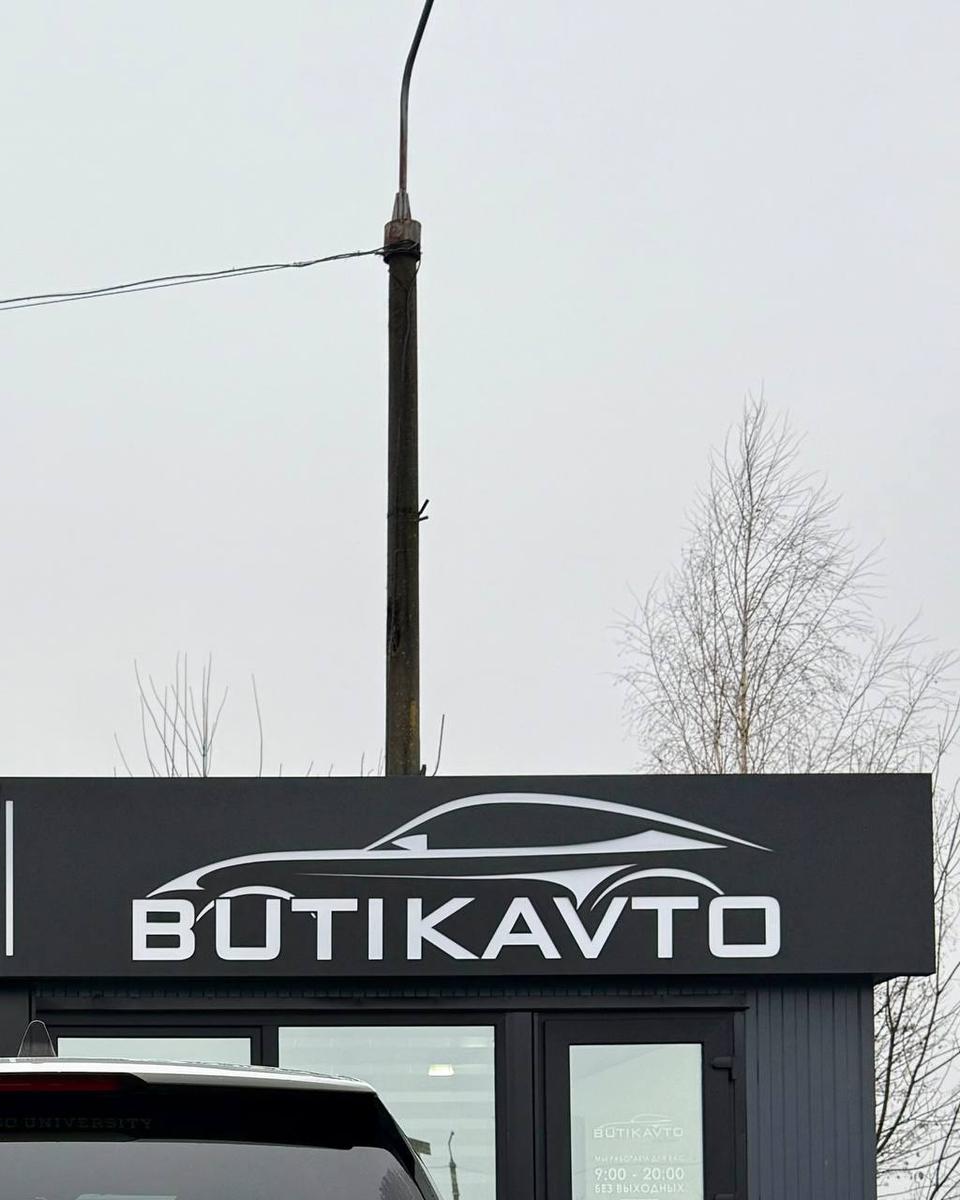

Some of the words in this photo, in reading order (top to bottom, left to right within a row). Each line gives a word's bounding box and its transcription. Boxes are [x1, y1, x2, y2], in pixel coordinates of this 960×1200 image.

[132, 895, 781, 960] BUTIKAVTO
[24, 1116, 153, 1130] UNIVERSITY
[593, 1127, 684, 1138] BUTIKAVTO
[594, 1167, 626, 1181] 9:00
[643, 1167, 685, 1181] 20:00
[594, 1183, 613, 1194] БЕЗ
[616, 1183, 685, 1194] ВЫХОДНЫХ
